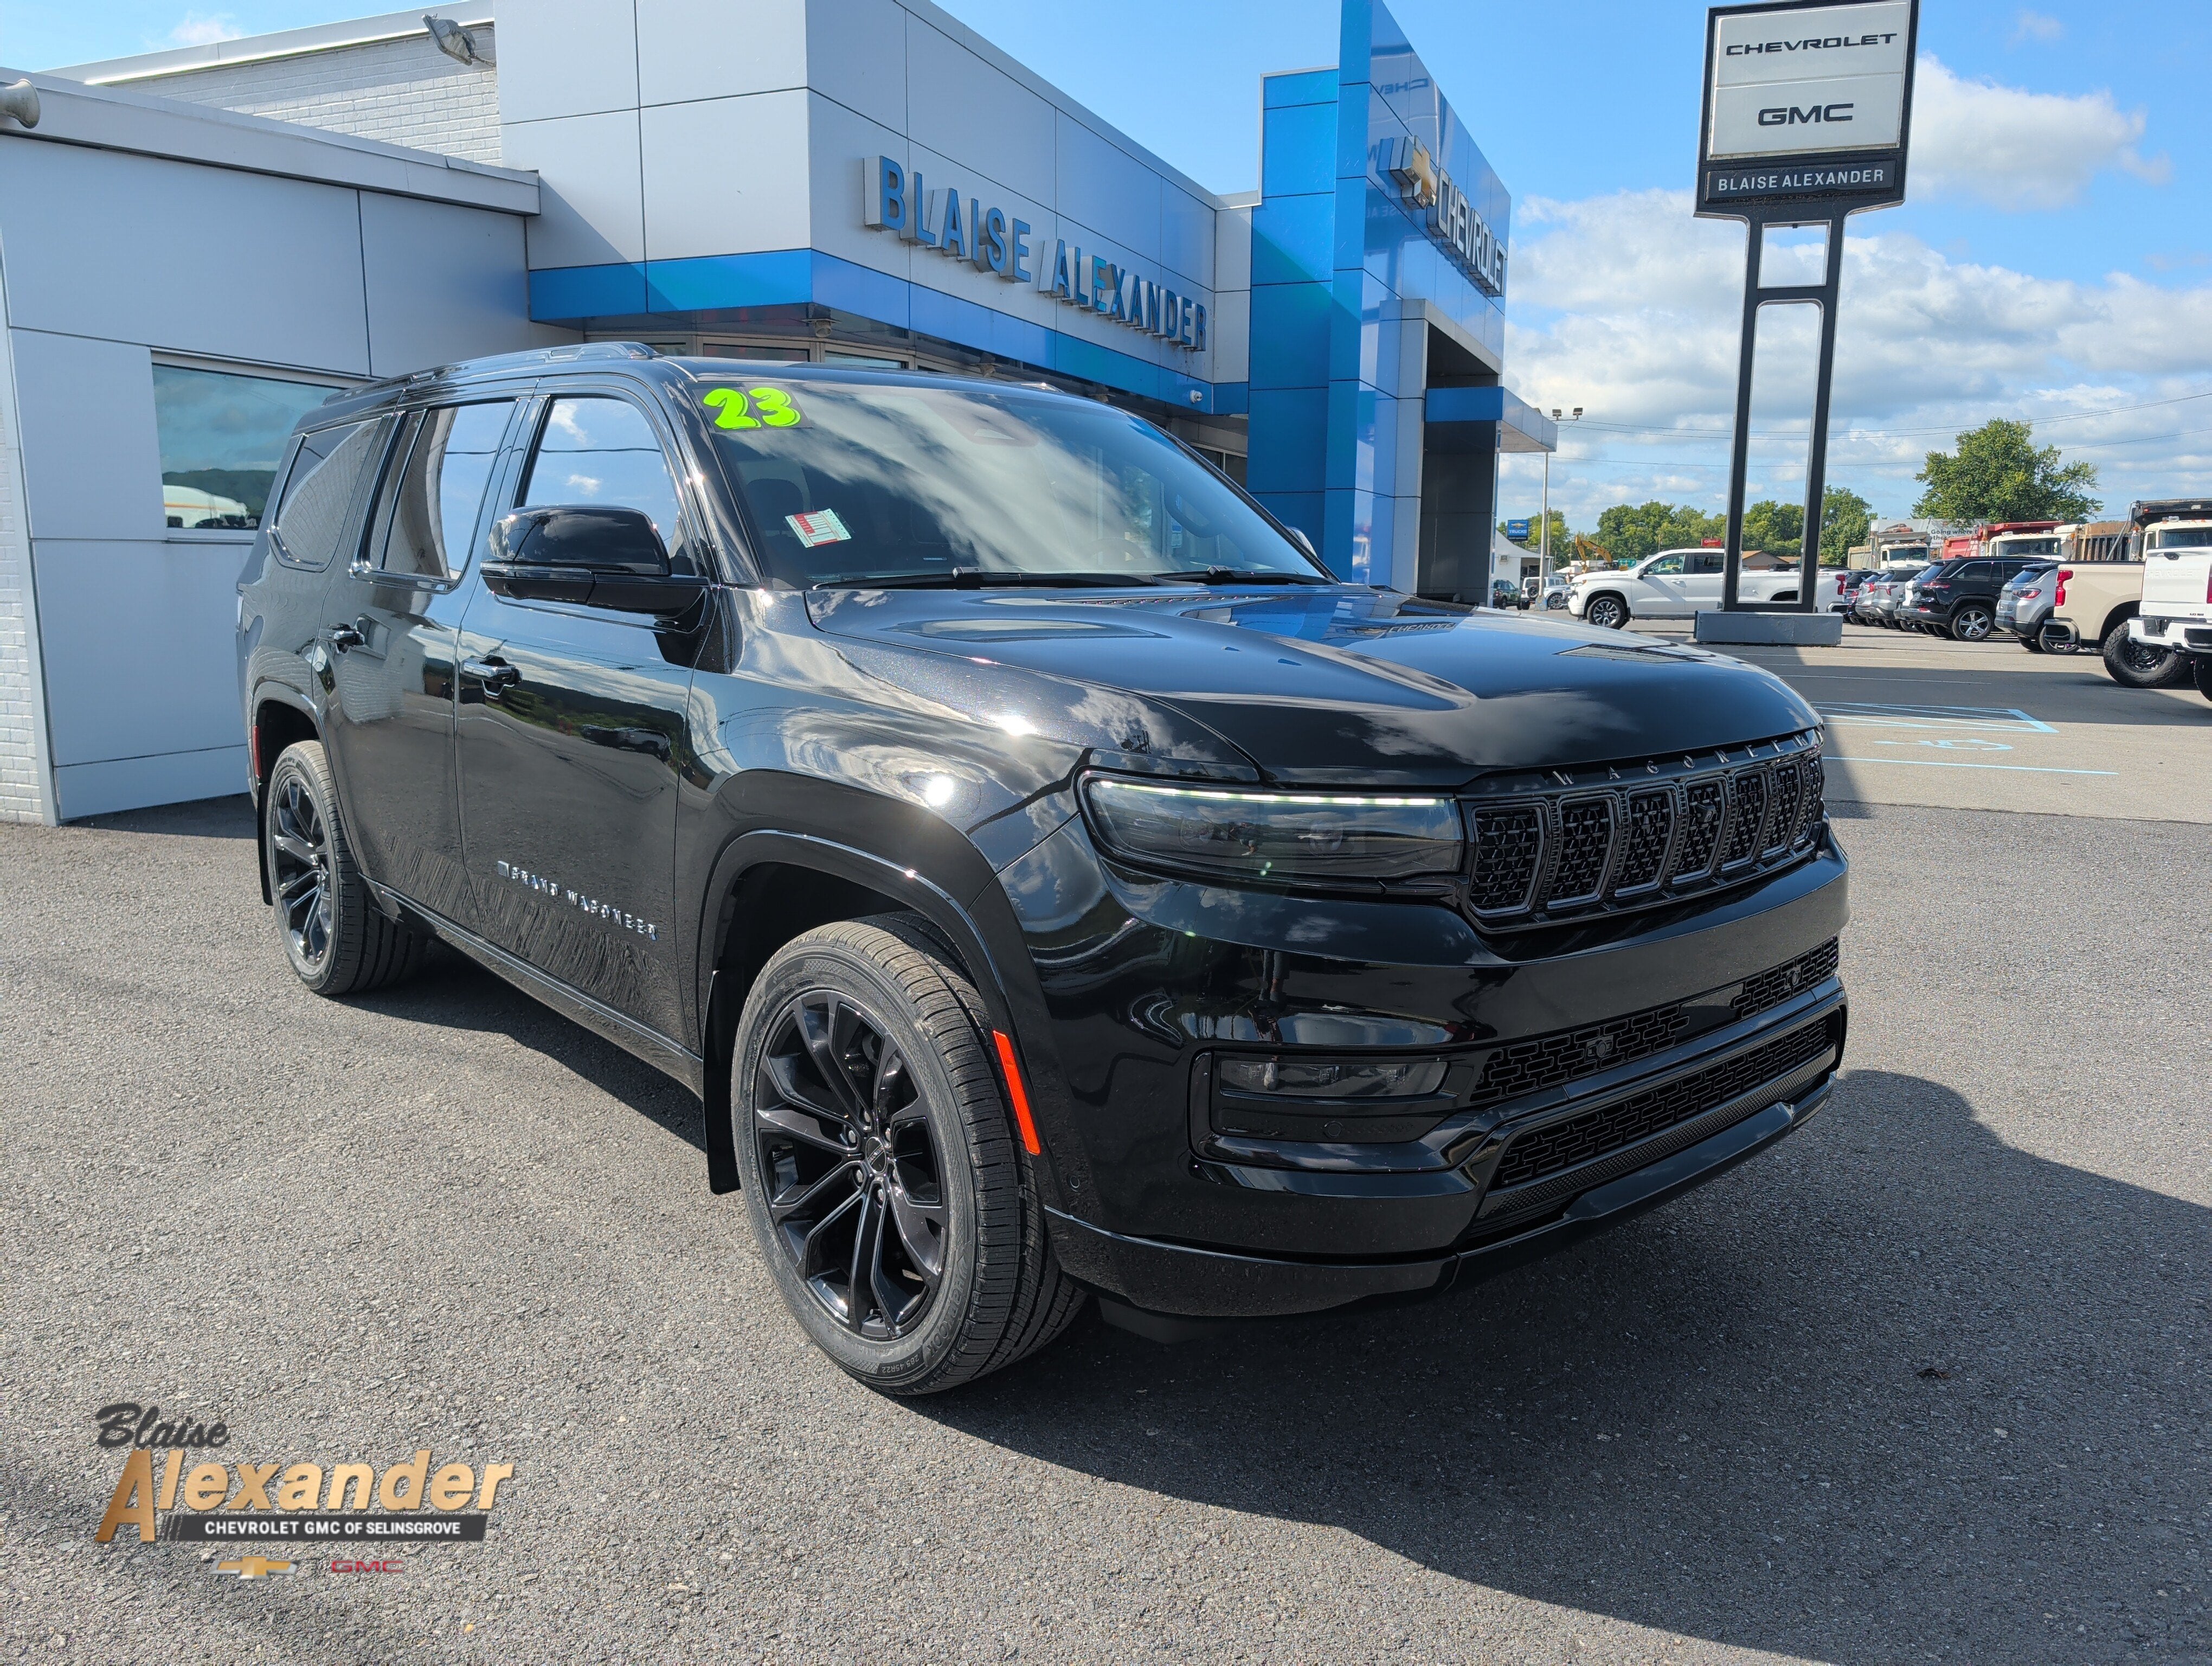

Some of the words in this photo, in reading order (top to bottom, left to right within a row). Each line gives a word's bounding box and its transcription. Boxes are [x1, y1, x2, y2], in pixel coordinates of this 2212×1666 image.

[1726, 33, 1898, 56] CHEVROLET
[1758, 103, 1854, 126] GMC
[1718, 176, 1777, 191] BLAISE
[1783, 169, 1884, 188] ALEXANDER
[869, 155, 1031, 283] BLAISE
[1042, 239, 1207, 352] ALEXANDER
[1432, 168, 1508, 297] CHEVROLET
[703, 387, 801, 430] 23
[1551, 732, 1809, 786] WAGONEER
[511, 866, 562, 897] GRAND
[566, 889, 660, 941] WAGONEER
[881, 1354, 920, 1374] 285/45R22
